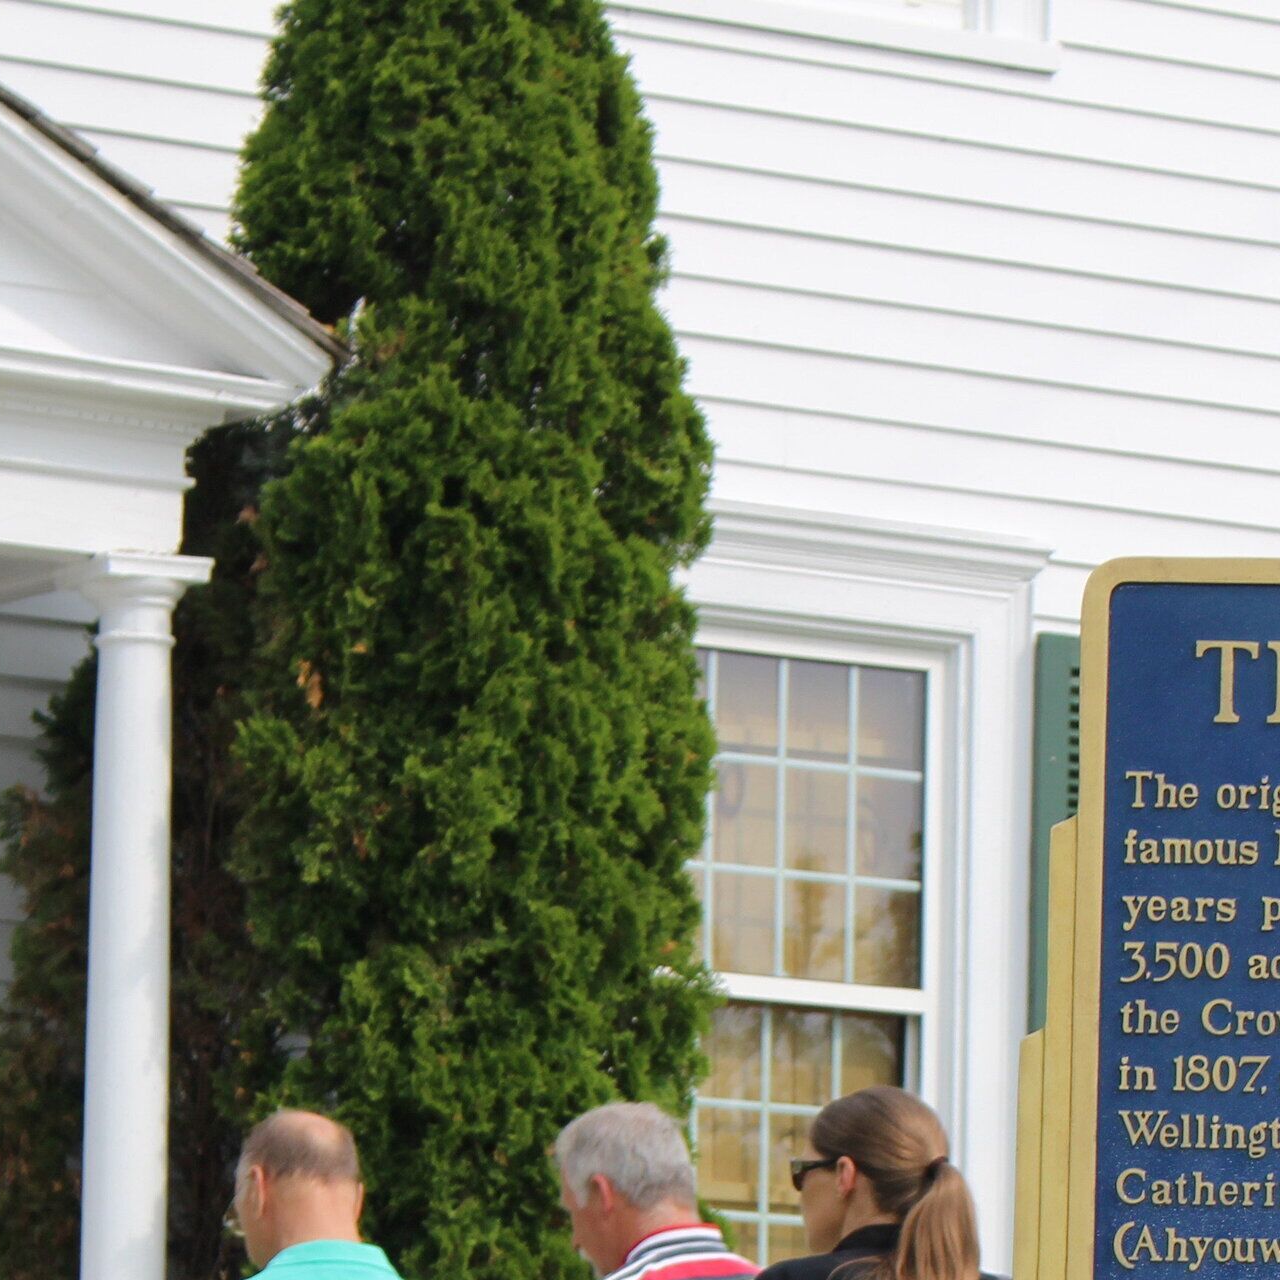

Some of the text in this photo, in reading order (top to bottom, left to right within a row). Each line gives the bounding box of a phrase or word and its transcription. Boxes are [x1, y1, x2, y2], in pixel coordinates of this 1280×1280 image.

[1124, 769, 1201, 810] The
[1123, 828, 1260, 866] famous
[1122, 894, 1238, 933] years
[1119, 940, 1232, 984] 3,500
[1120, 998, 1182, 1035] the
[1118, 1055, 1158, 1092] in
[1172, 1054, 1271, 1093] 1807,
